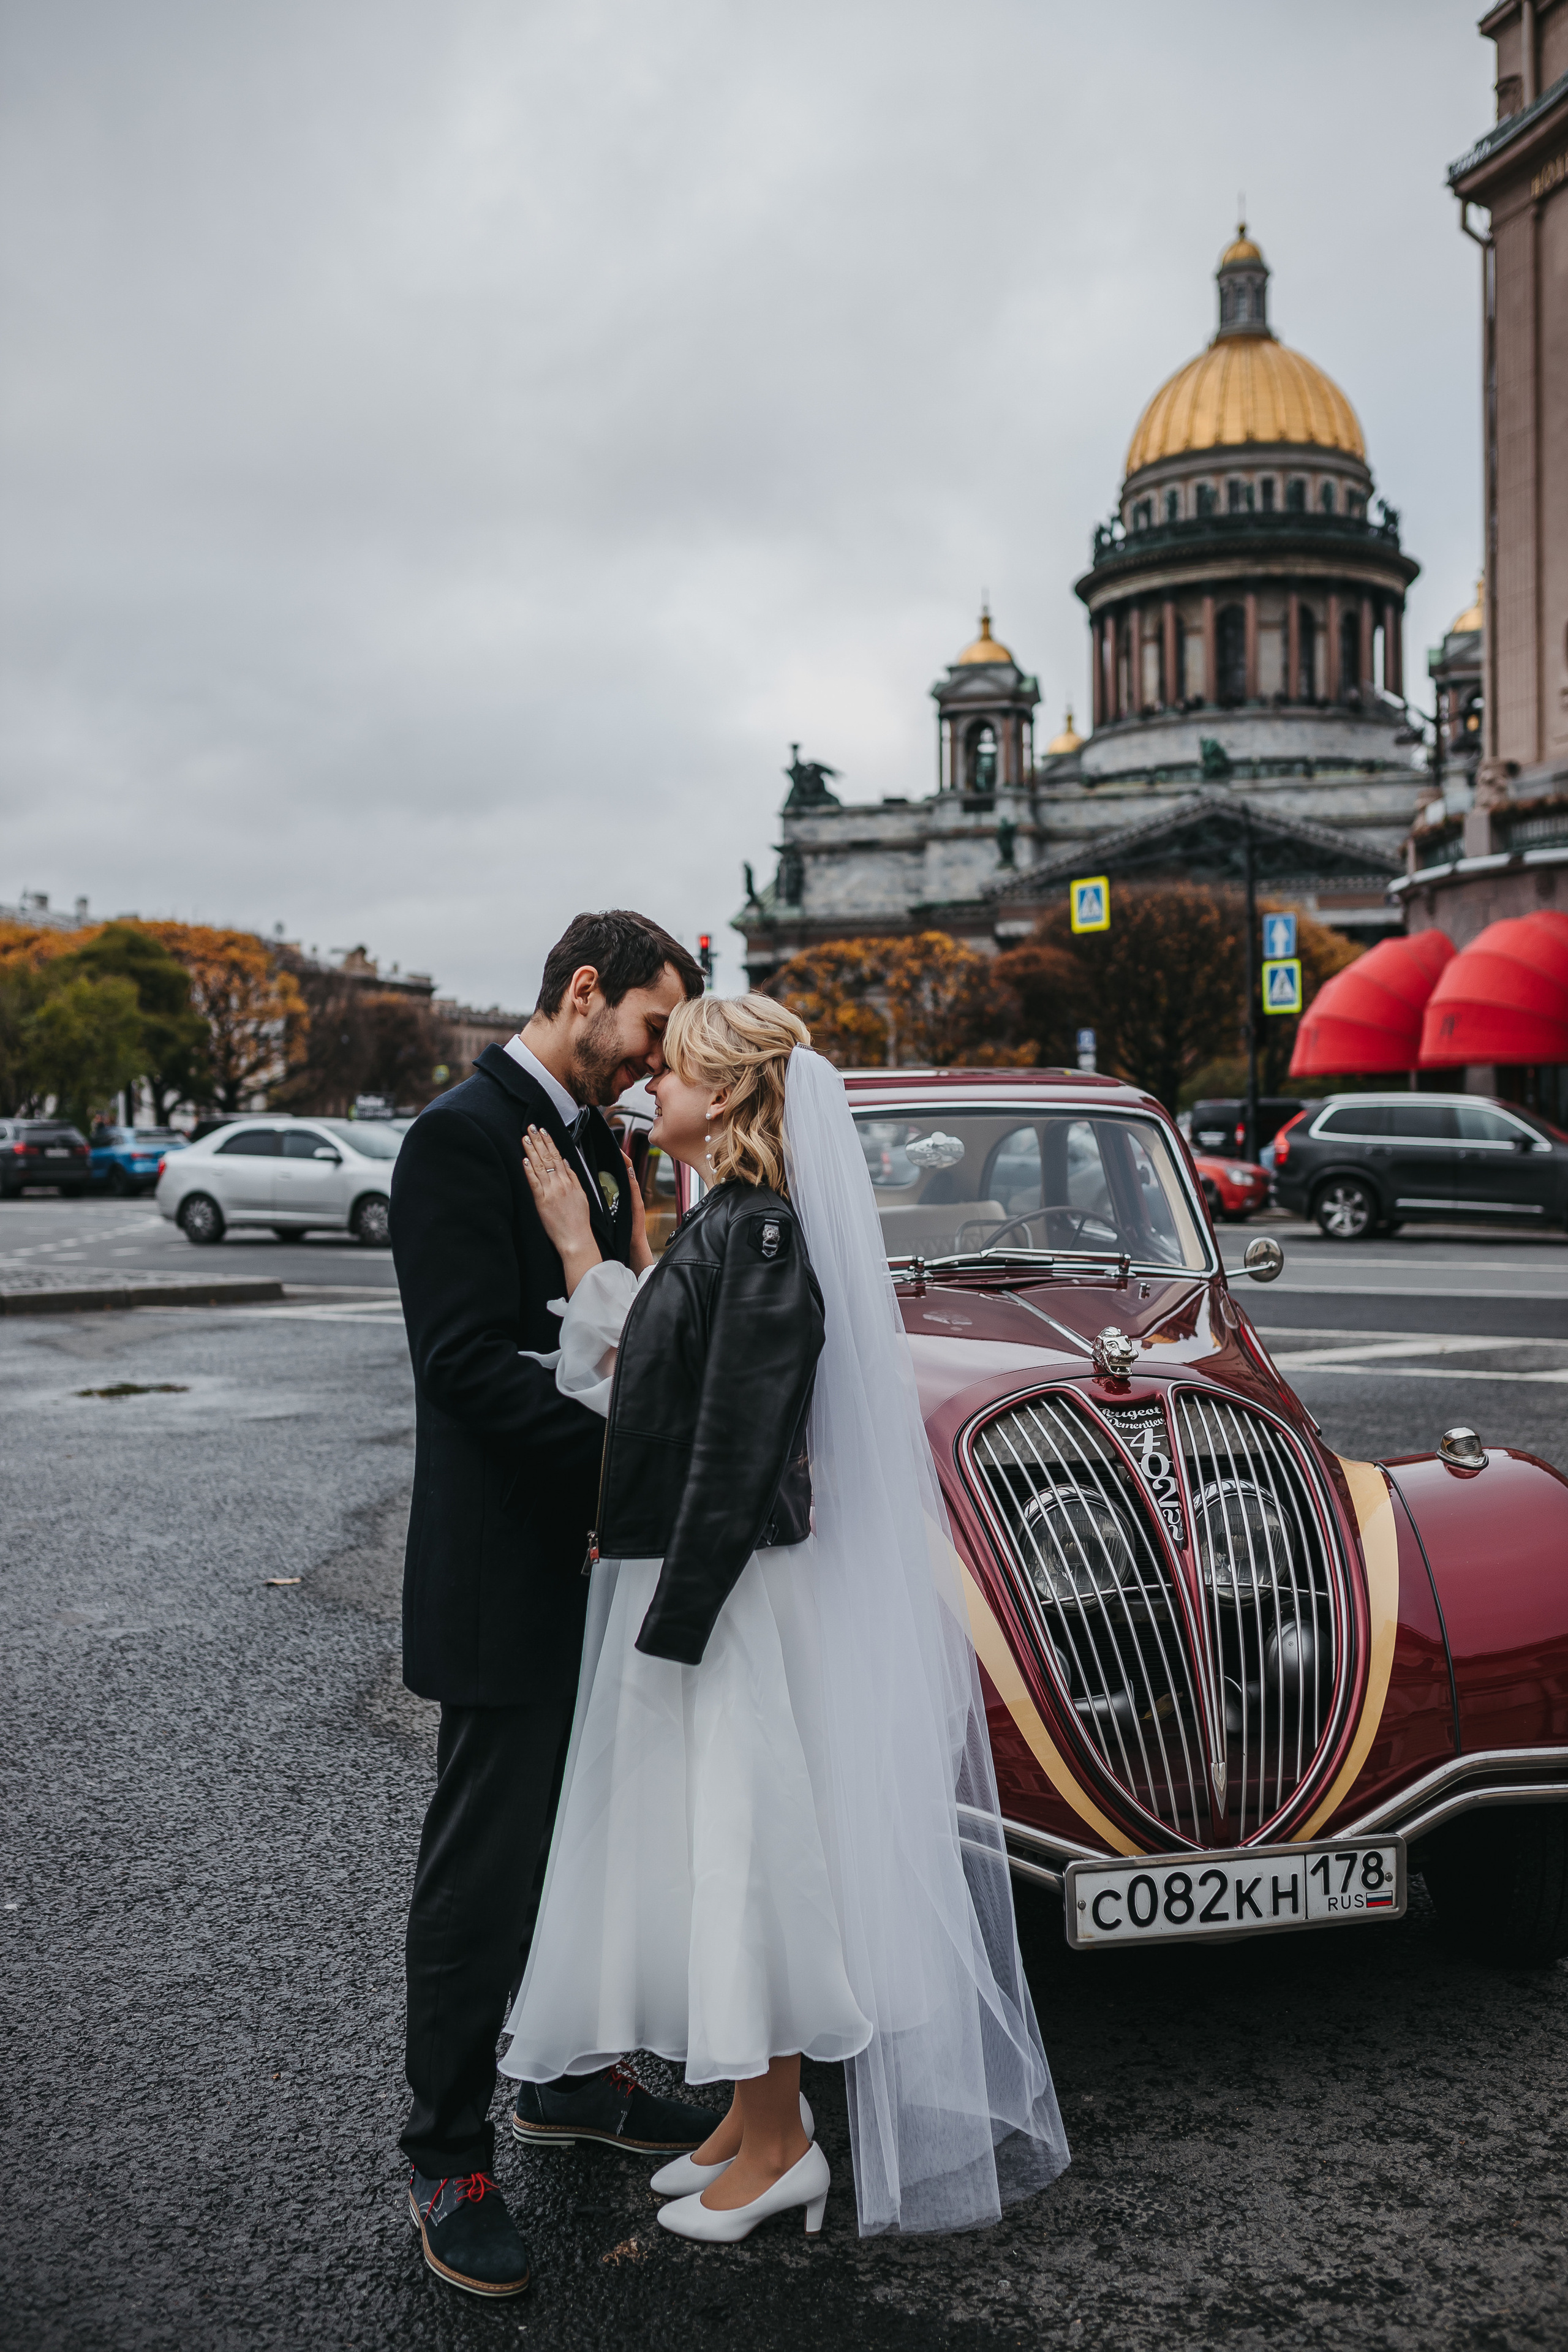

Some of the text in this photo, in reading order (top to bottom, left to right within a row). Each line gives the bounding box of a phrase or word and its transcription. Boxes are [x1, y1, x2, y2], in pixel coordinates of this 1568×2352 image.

[1099, 1406, 1162, 1420] Peugeot
[1129, 1428, 1180, 1507] 402
[1310, 1850, 1385, 1896] 178
[1328, 1894, 1365, 1912] RUS
